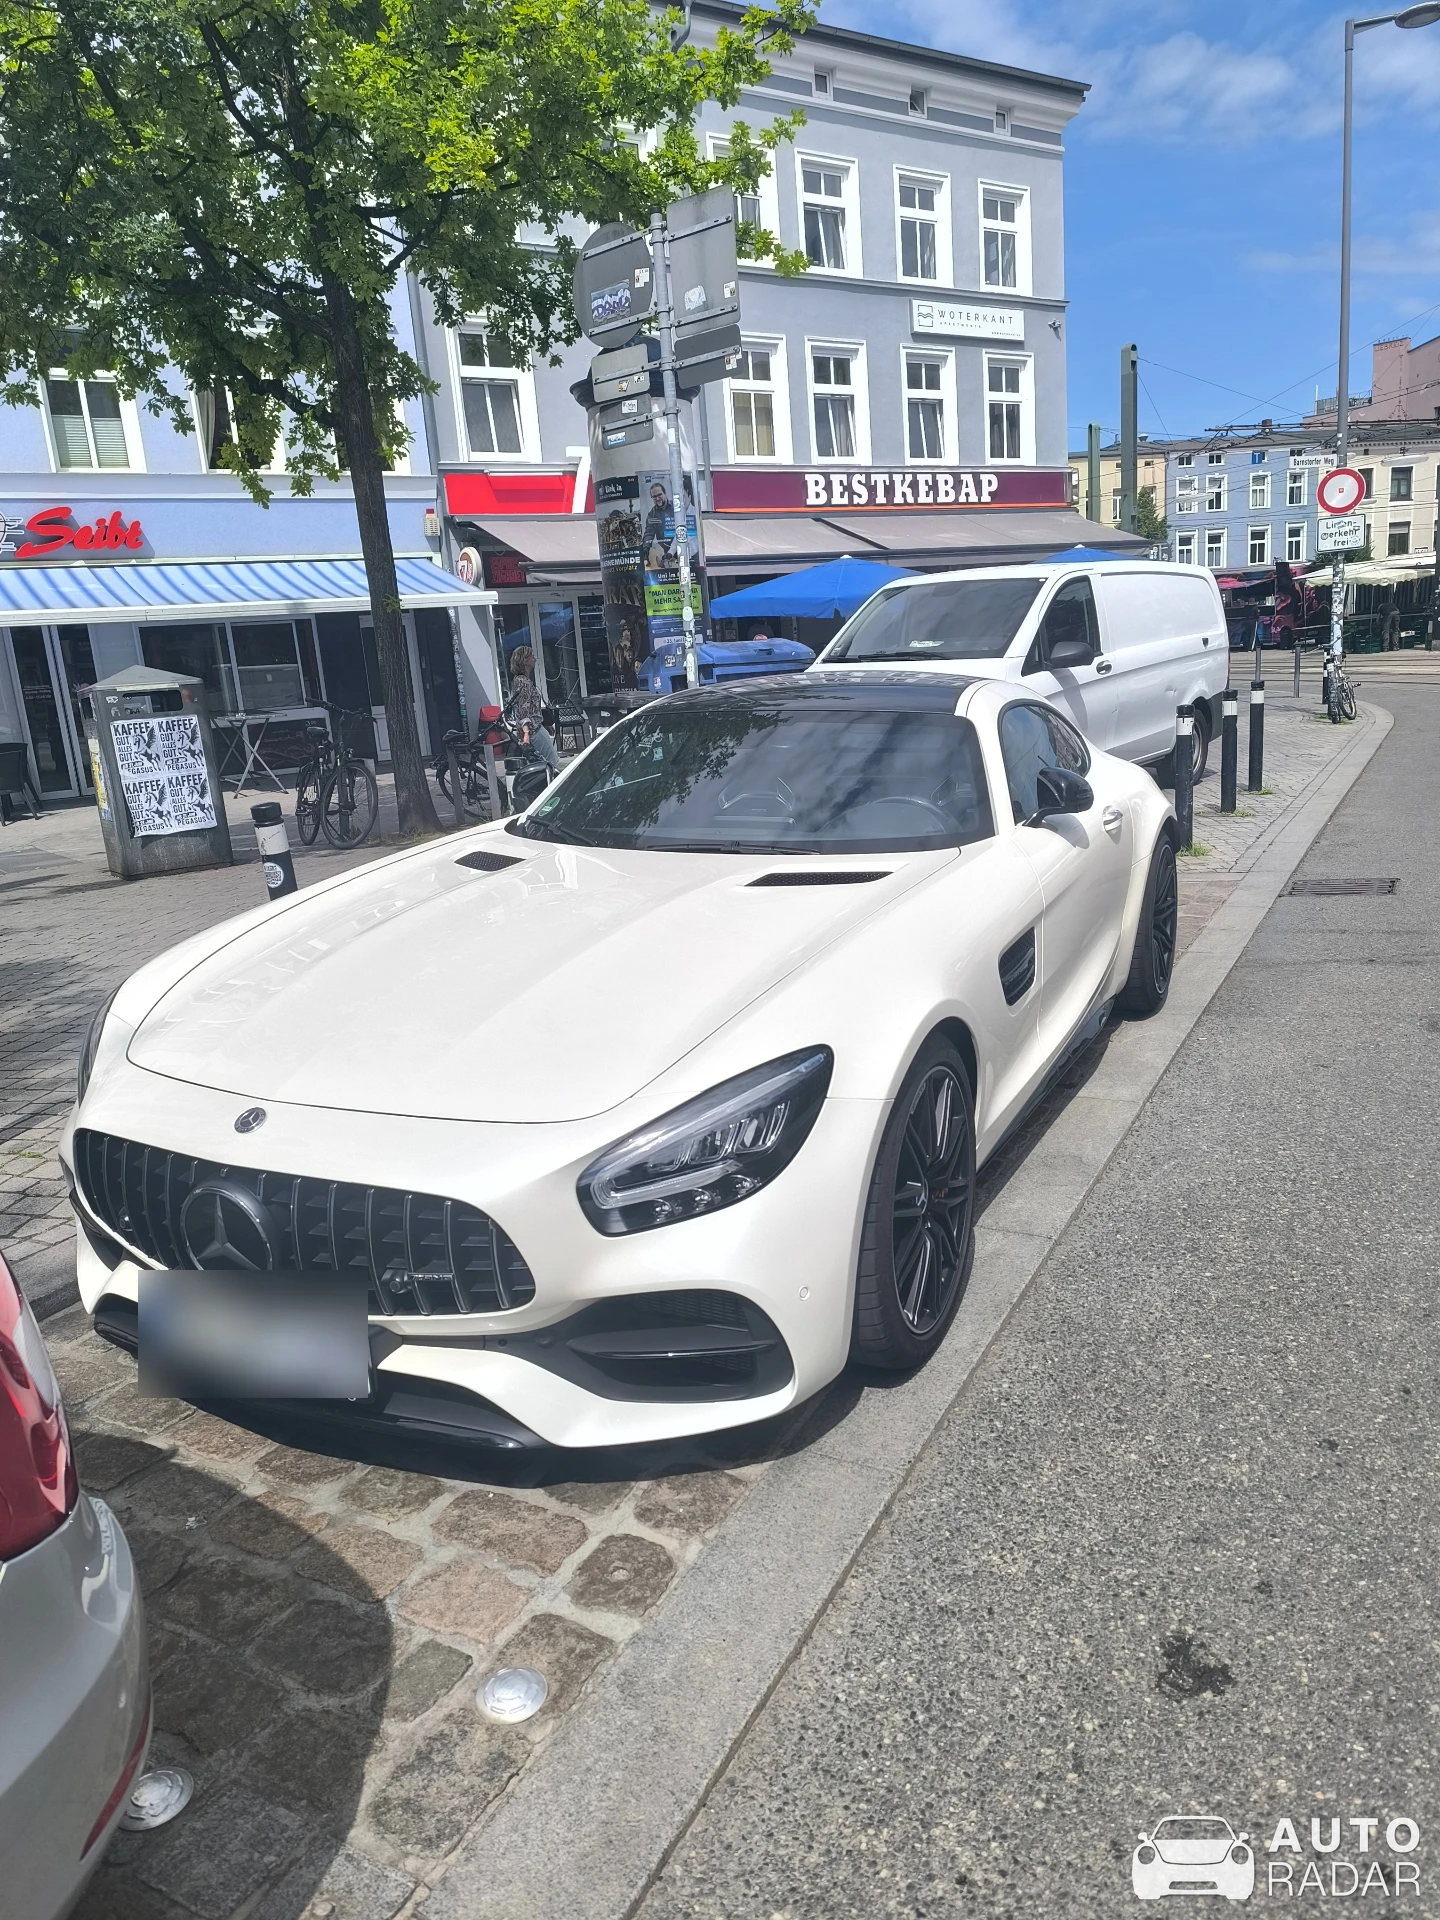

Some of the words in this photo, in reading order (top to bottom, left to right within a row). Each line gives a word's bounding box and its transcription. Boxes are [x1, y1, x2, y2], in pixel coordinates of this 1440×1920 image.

[937, 309, 1013, 325] WOTERKANT
[1293, 457, 1322, 467] Barnstorfer
[1323, 457, 1335, 467] Weg
[804, 473, 999, 506] BESTKEBAP
[1325, 519, 1357, 530] Lin-
[14, 506, 144, 559] Seibt
[1321, 528, 1358, 540] erkehr
[1333, 537, 1349, 547] frei
[653, 597, 672, 605] MEHR
[117, 744, 132, 753] ALLES
[162, 741, 177, 749] ALLES
[127, 766, 154, 775] EGASUS
[167, 761, 197, 771] PEGASUS
[171, 797, 187, 805] ALLES
[129, 803, 144, 811] ALLES
[177, 815, 207, 826] PEGASUS
[136, 822, 165, 833] PEGASUS
